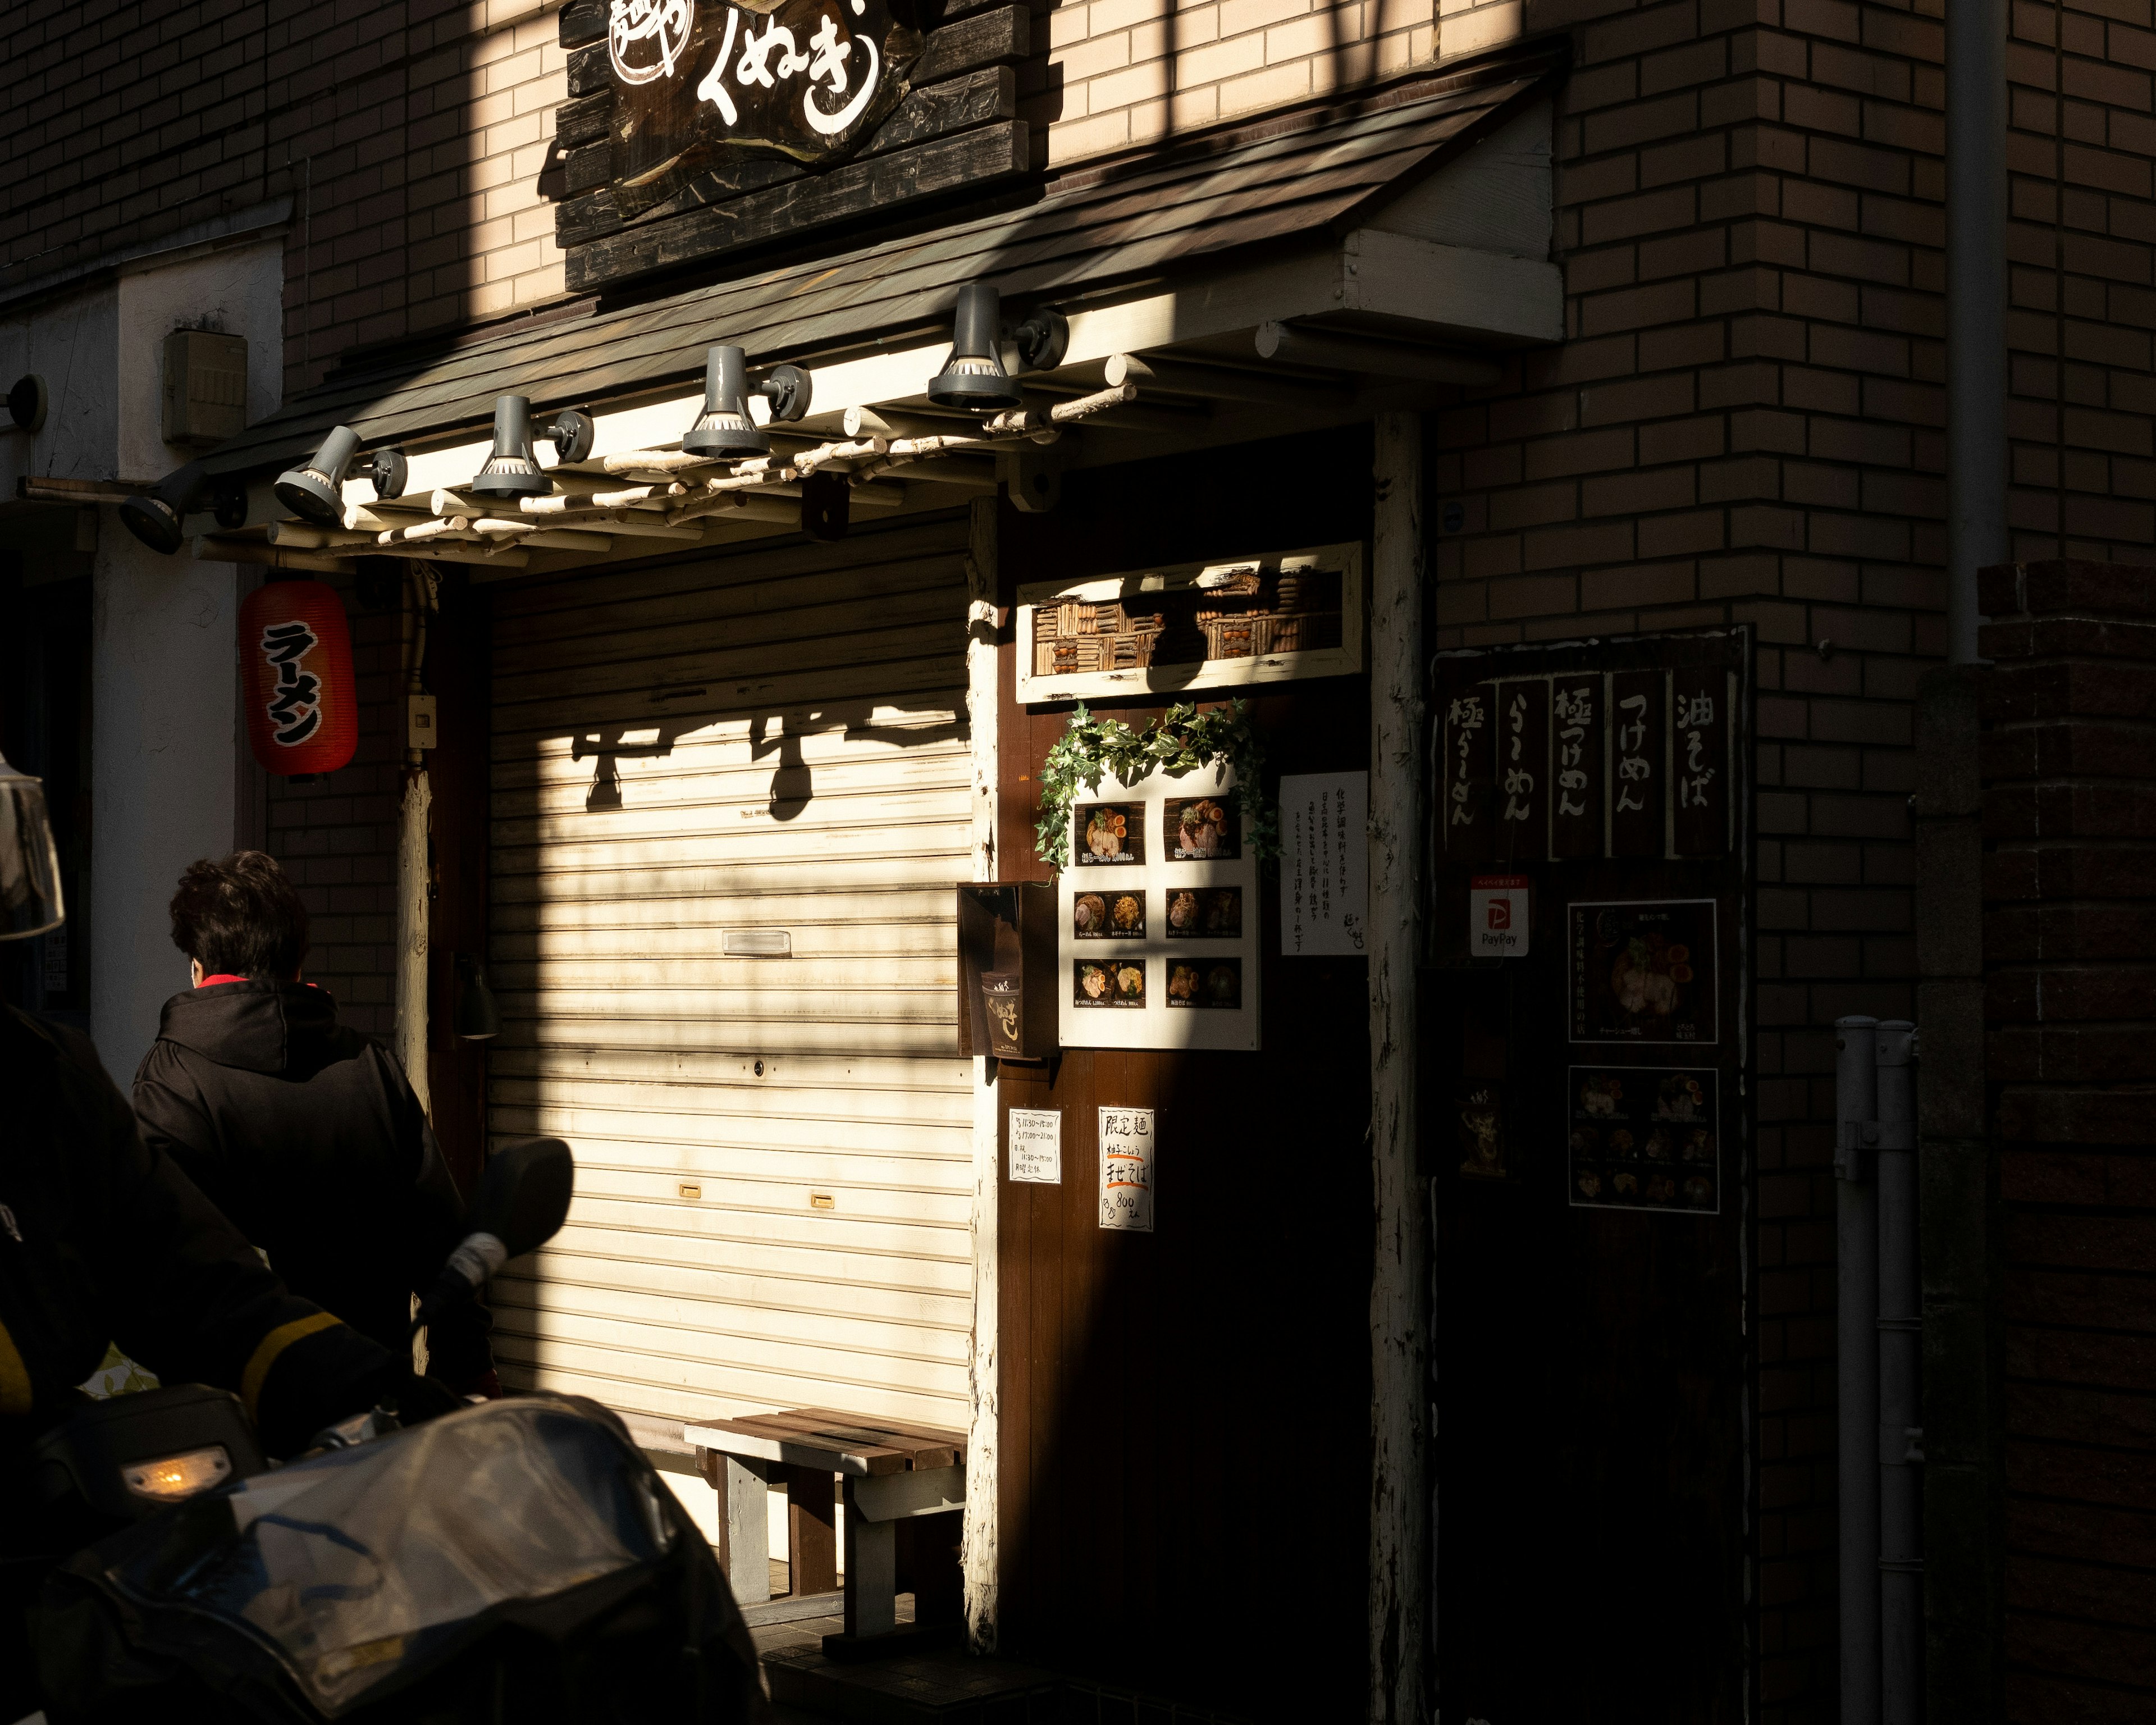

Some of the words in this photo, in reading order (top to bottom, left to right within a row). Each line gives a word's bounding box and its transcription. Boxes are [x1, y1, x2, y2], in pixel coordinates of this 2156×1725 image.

[697, 0, 879, 135] くぬぎ
[262, 622, 321, 746] ラーメン
[1447, 696, 1484, 826] 極らーめん
[1504, 693, 1534, 821] らーめん
[1554, 687, 1593, 816] 極つけめん
[1616, 694, 1651, 813] つけめん
[1677, 688, 1716, 809] 油そば
[1482, 933, 1516, 947] PayPay
[1105, 1115, 1149, 1137] 限定麺
[1106, 1162, 1150, 1184] まぜそば
[1107, 1143, 1140, 1156] 柚子こしょう
[1116, 1192, 1134, 1208] 800
[1129, 1208, 1140, 1219] えん
